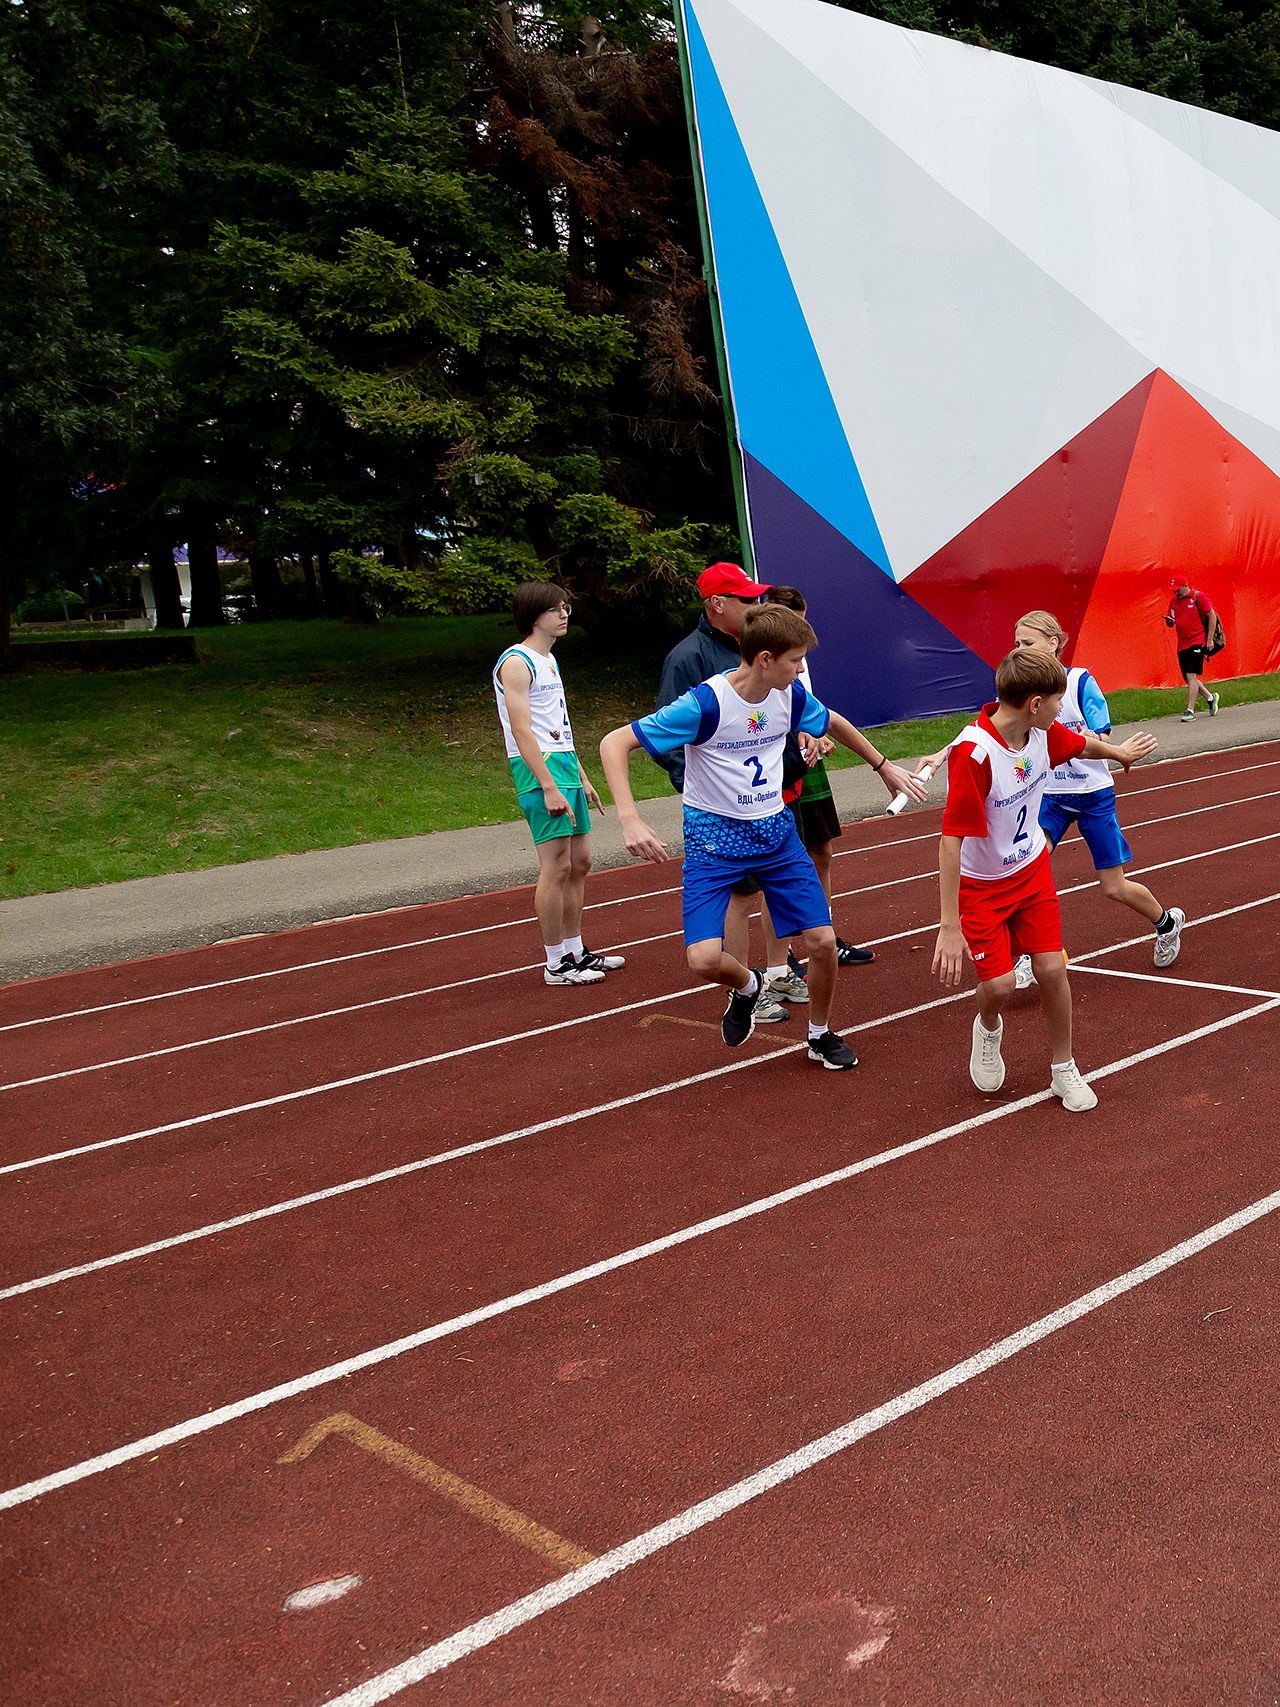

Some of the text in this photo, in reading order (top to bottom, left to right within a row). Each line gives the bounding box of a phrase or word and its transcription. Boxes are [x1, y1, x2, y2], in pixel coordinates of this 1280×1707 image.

[716, 738, 759, 750] ПРЕЗИДЕНТСКИЕ
[743, 755, 768, 788] 2
[737, 794, 753, 806] ВДЦ
[1012, 804, 1029, 845] 2
